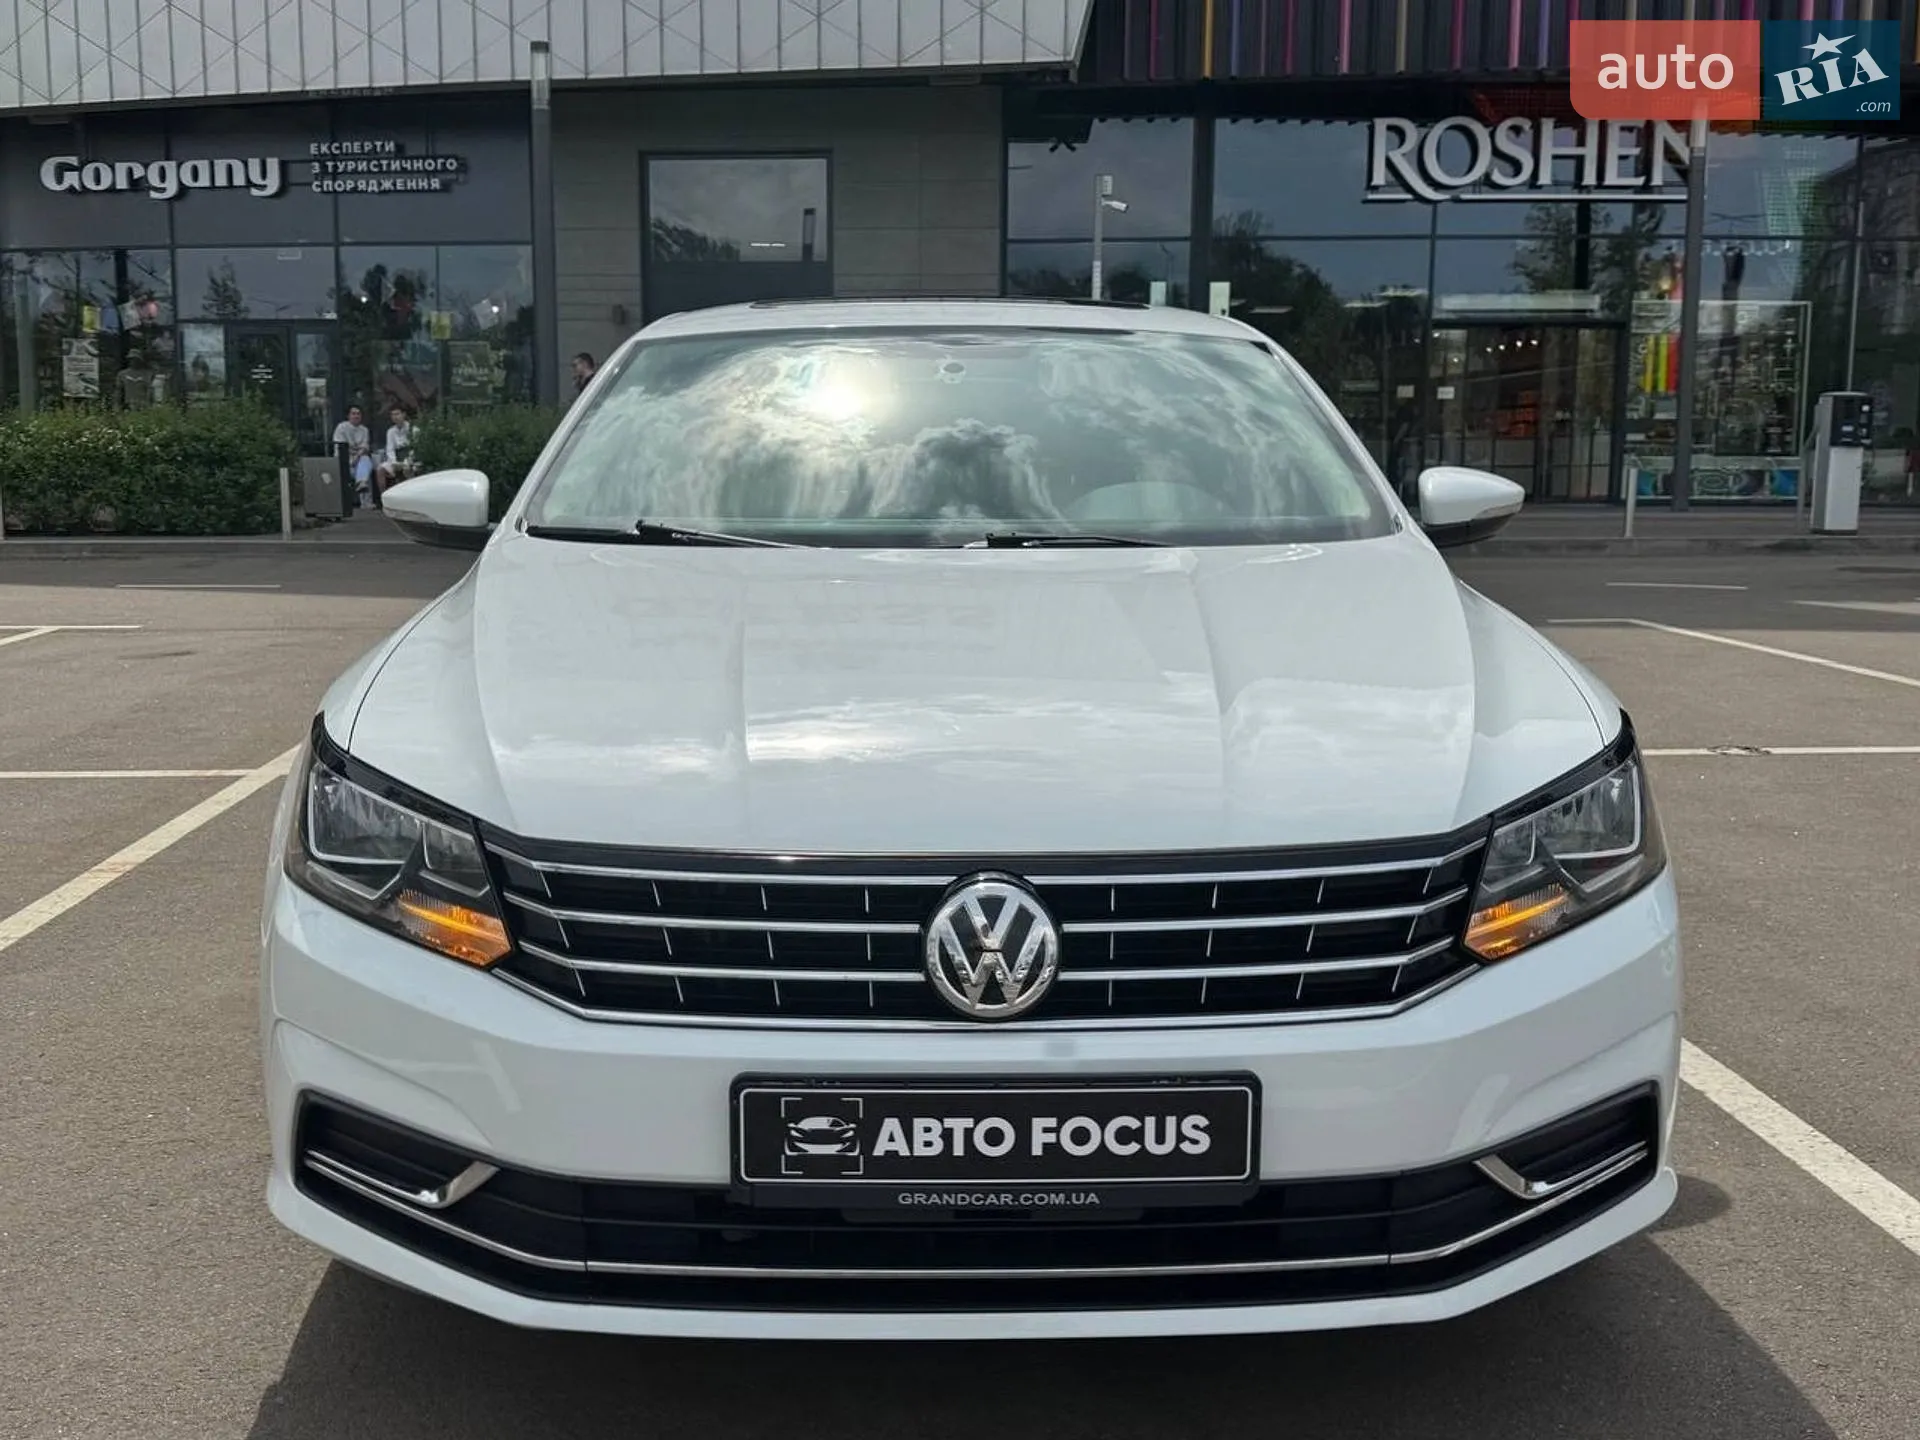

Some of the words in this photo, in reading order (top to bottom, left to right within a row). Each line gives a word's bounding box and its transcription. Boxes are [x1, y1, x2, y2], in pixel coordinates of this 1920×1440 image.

[309, 141, 396, 155] ЕКСПЕРТИ
[325, 158, 458, 173] ТУРИСТИЧНОГО
[1371, 116, 1691, 201] ROSHEN
[40, 155, 281, 200] Gorgany
[311, 178, 441, 193] СПОРЯДЖЕННЯ
[1030, 1113, 1211, 1157] FOCUS
[897, 1192, 1100, 1206] GRANDCAR.COM.UA
